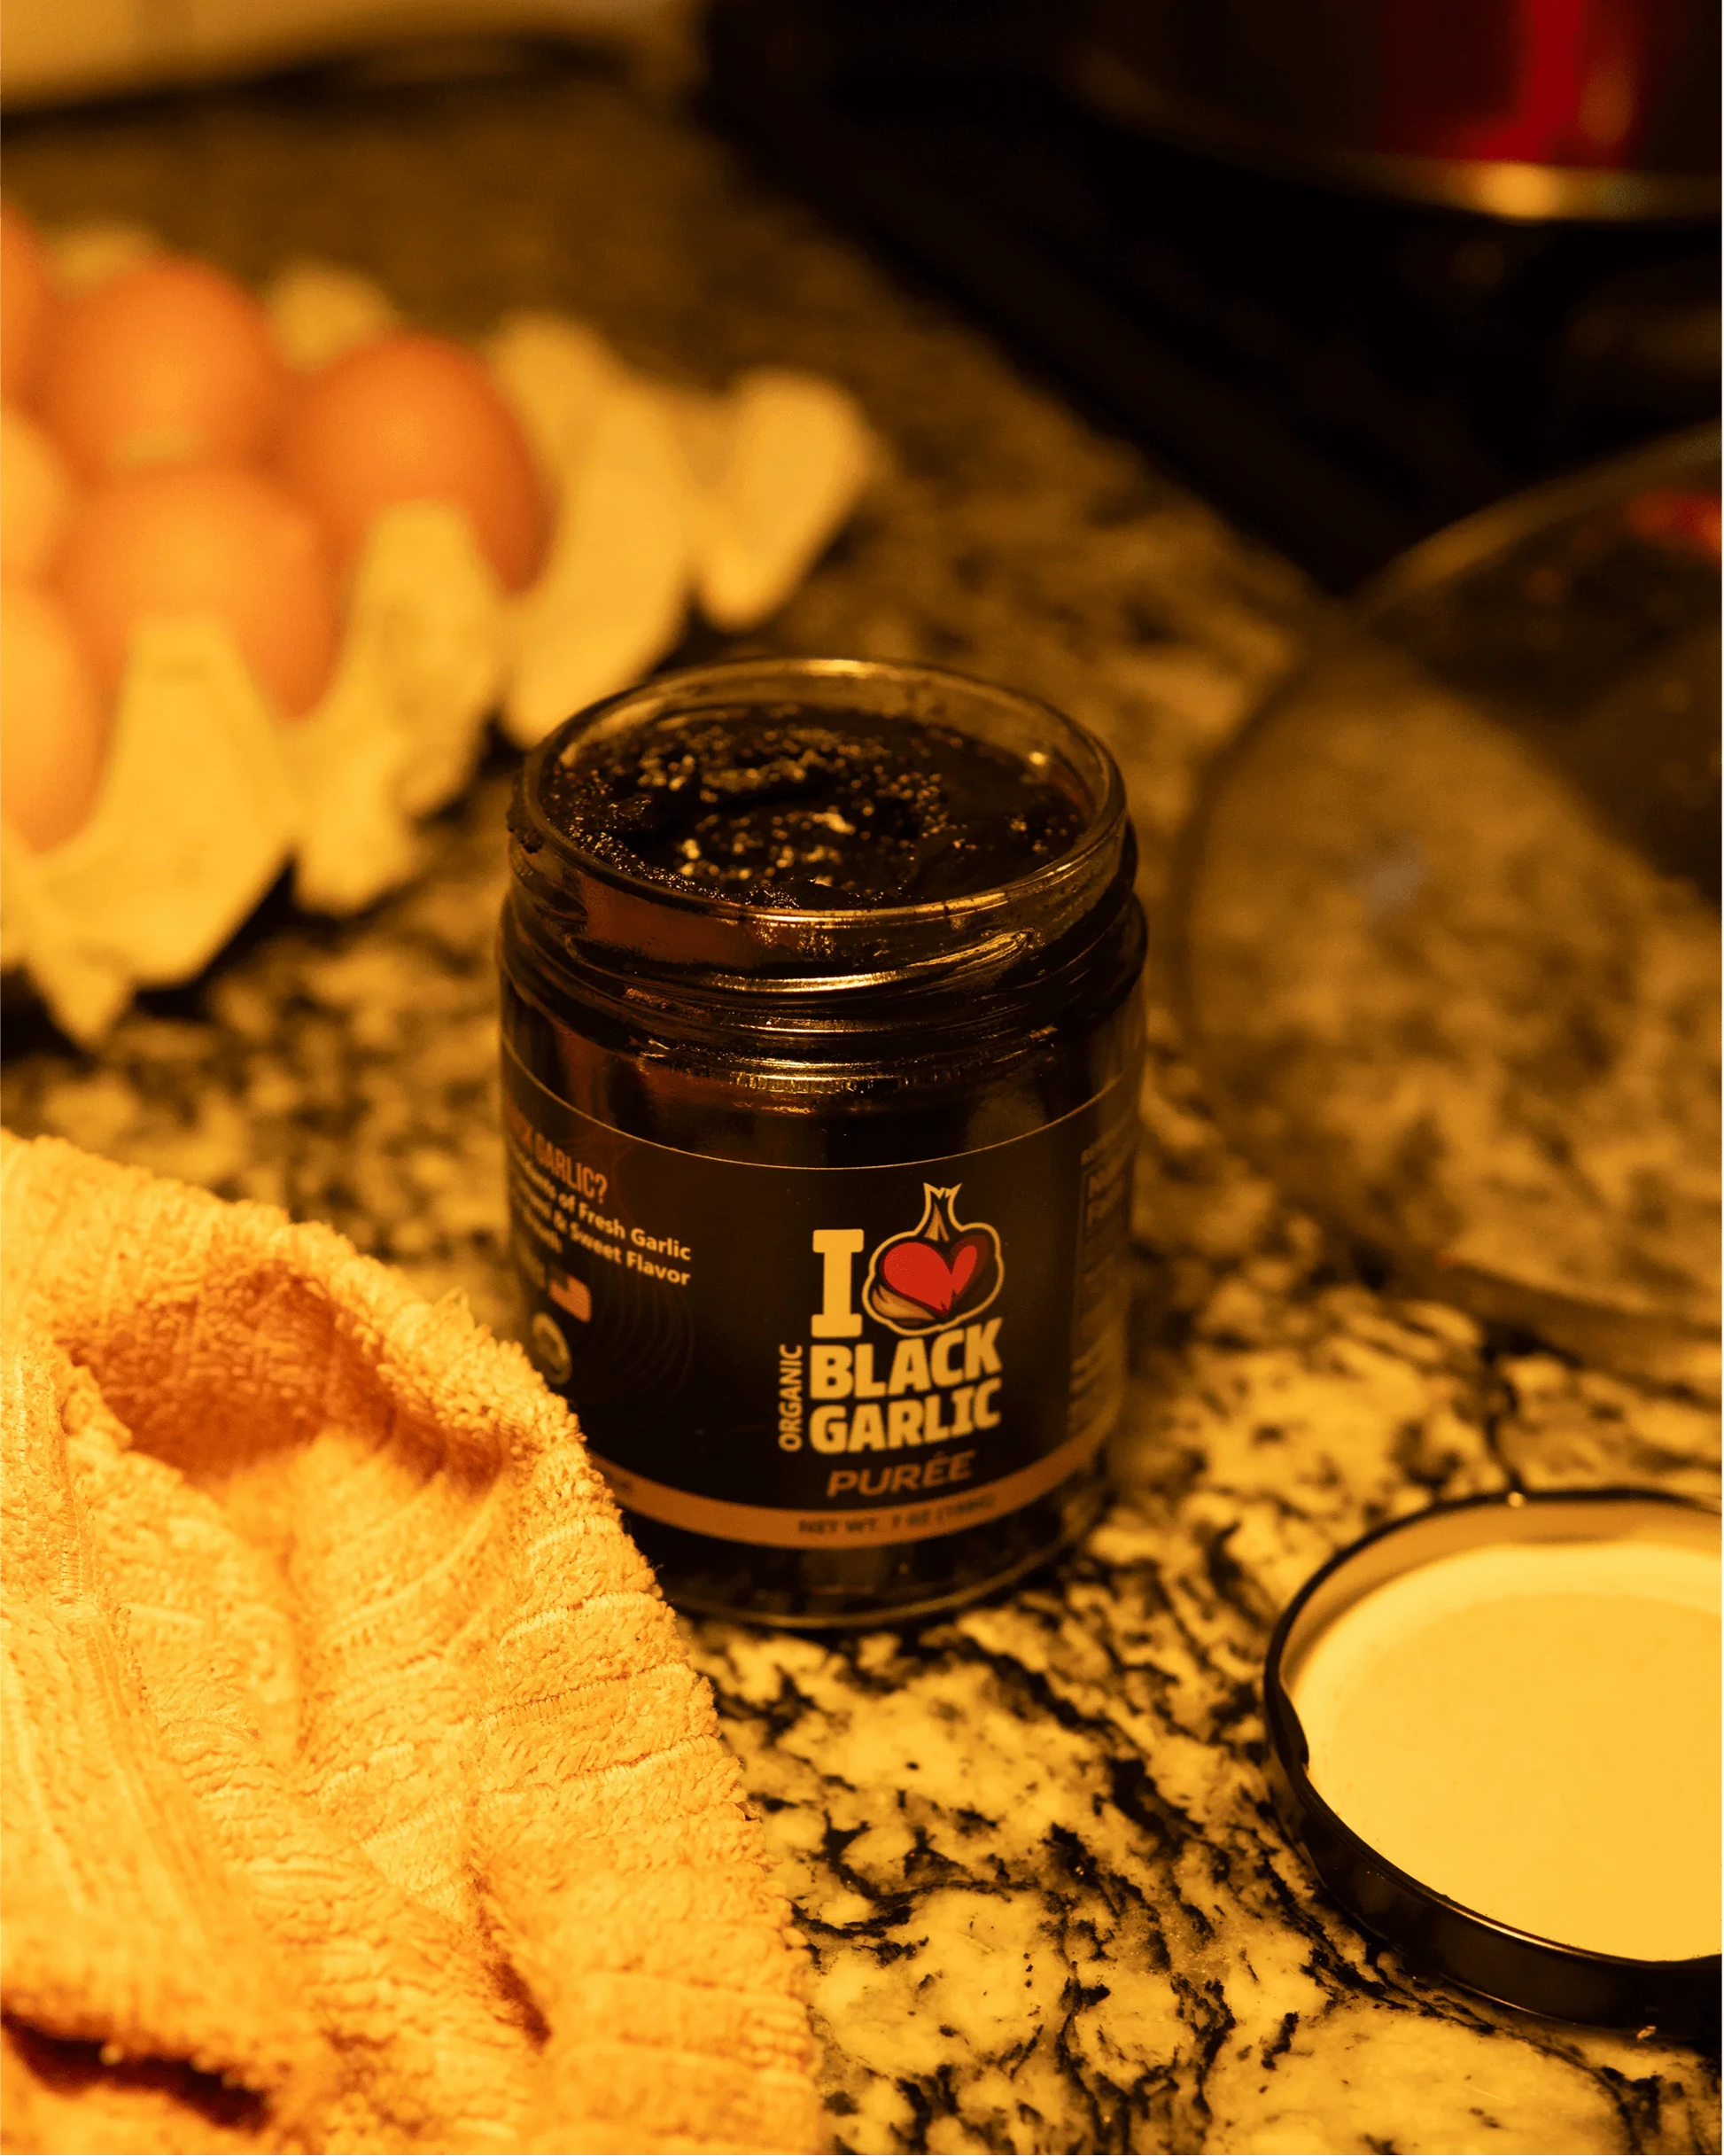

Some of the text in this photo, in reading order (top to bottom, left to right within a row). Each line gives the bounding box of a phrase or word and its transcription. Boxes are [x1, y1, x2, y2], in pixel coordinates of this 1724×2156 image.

[570, 1222, 622, 1265] Sweet
[626, 1250, 692, 1287] Flavor
[579, 1202, 625, 1240] Fresh
[631, 1227, 691, 1262] Garlic
[811, 1229, 865, 1338] I
[809, 1317, 1004, 1401] BLACK
[778, 1343, 804, 1452] ORGANIC
[809, 1376, 1004, 1454] GARLIC
[827, 1449, 977, 1498] PURÉE
[799, 1518, 837, 1535] NET
